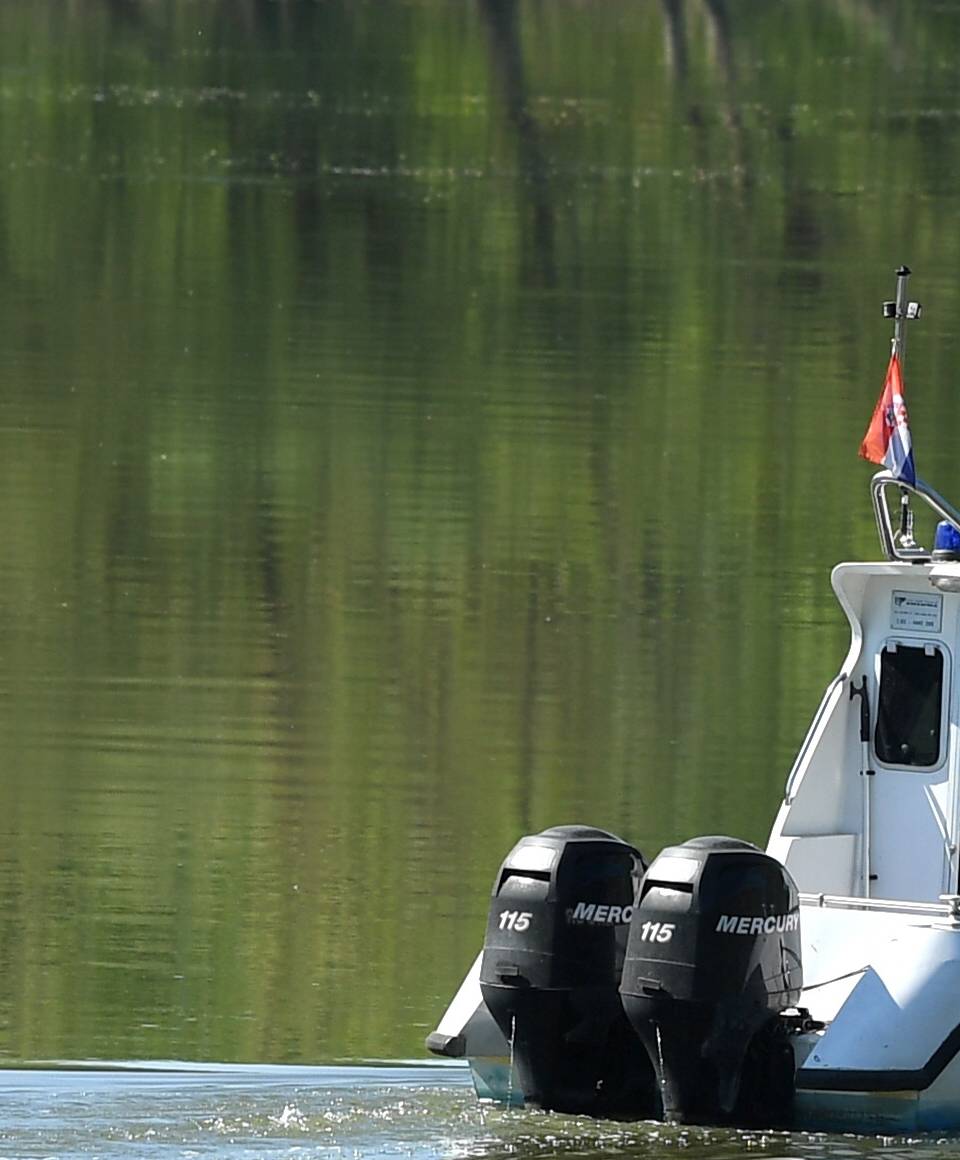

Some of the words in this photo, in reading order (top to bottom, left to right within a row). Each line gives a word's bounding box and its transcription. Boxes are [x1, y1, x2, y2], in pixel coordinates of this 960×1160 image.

[498, 909, 533, 932] 115
[640, 920, 676, 943] 115
[715, 913, 800, 935] MERCURY
